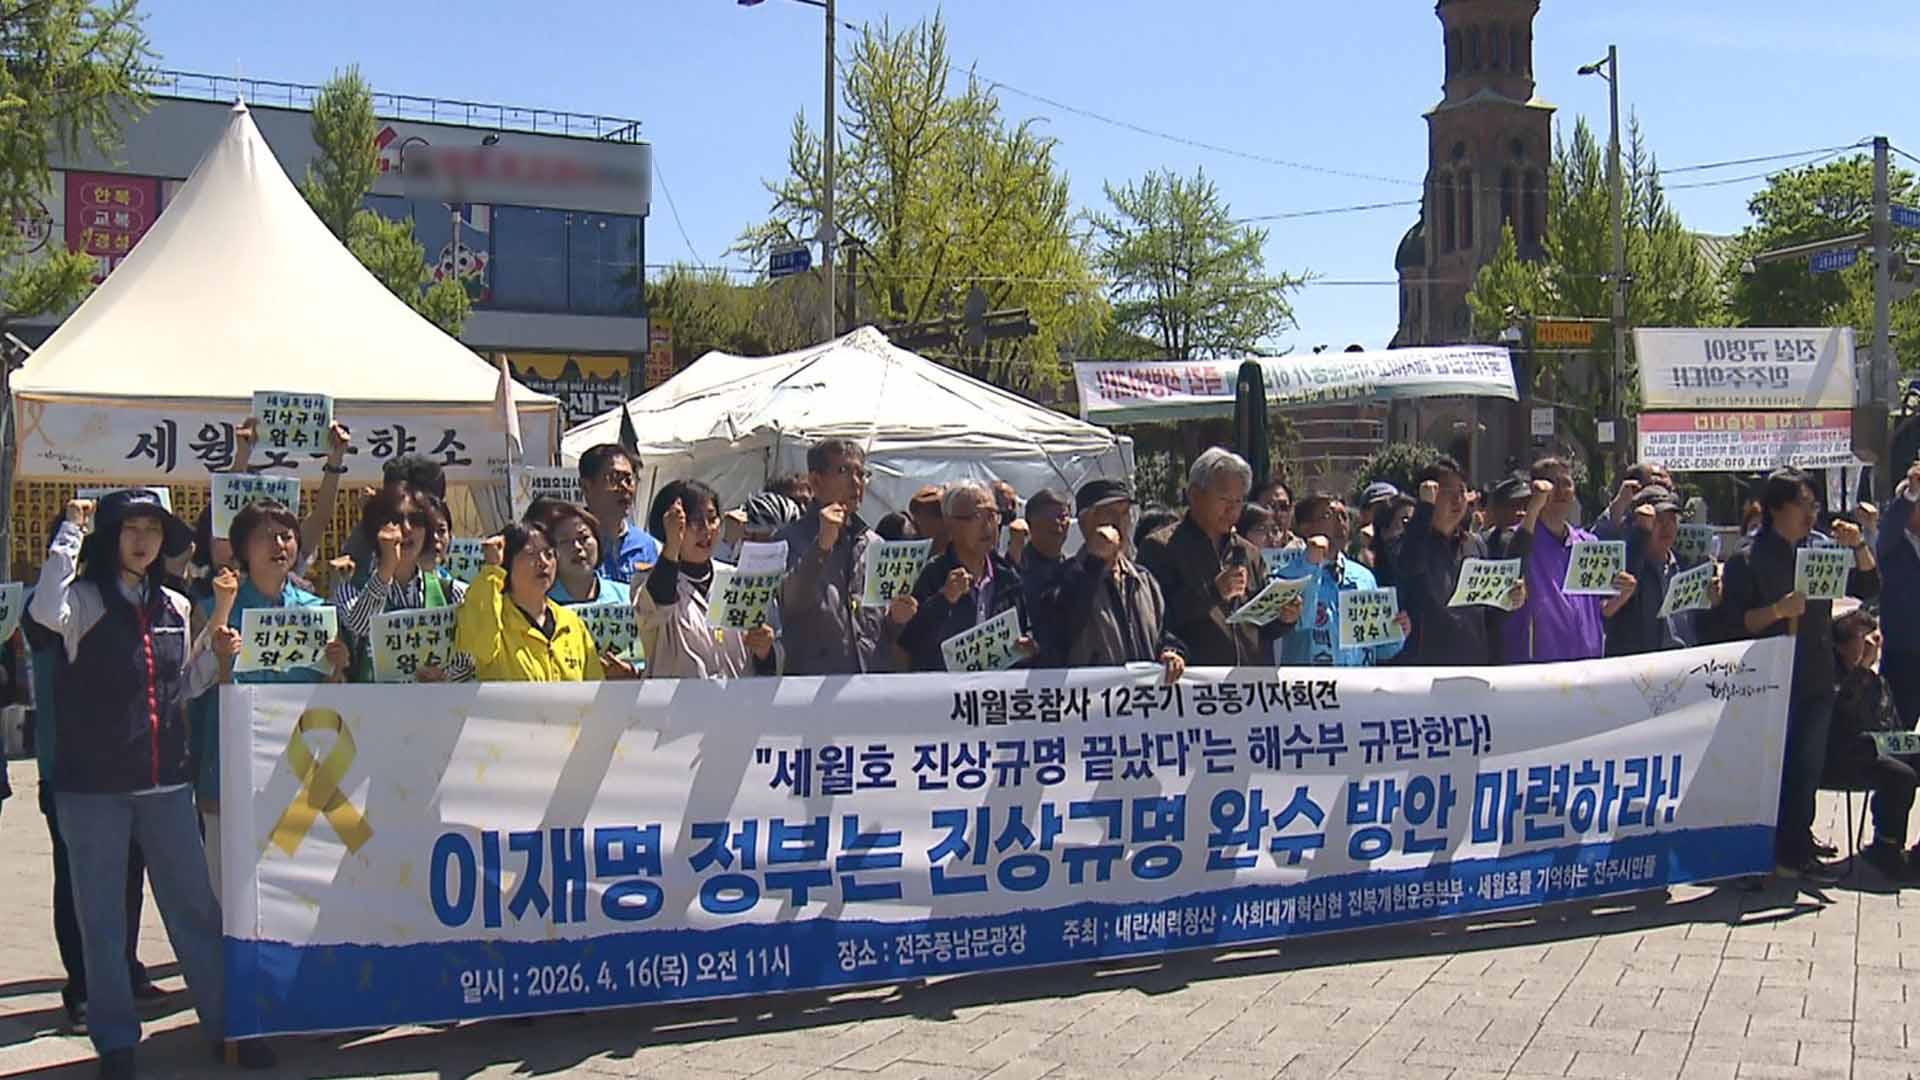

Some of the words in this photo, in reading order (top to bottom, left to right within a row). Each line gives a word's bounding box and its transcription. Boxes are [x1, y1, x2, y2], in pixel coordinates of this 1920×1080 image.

[263, 410, 326, 426] 진상규명
[254, 629, 328, 648] 진상규명
[951, 687, 1090, 726] 세월호참사
[1099, 682, 1184, 718] 12주기
[1193, 679, 1341, 716] 공동기자회견
[757, 744, 898, 798] "세월호
[911, 735, 1068, 792] 진상규명
[1081, 728, 1237, 782] 끝났다"는
[1247, 721, 1349, 771] 해수부
[1358, 714, 1492, 764] 규탄한다!
[429, 823, 664, 930] 이재명
[689, 812, 903, 916] 정부는
[926, 793, 1188, 899] 진상규명
[1206, 786, 1327, 872] 완수
[1346, 773, 1457, 861] 방안
[1471, 754, 1682, 846] 마련하라!
[1062, 917, 1099, 948] 주최
[1115, 904, 1216, 944] 내란세력청산
[1232, 893, 1343, 932] 사회대개혁실현
[1537, 863, 1590, 894] 기억하는
[460, 967, 504, 1004] 일시
[527, 962, 590, 997] 2026.
[597, 962, 617, 991] 4.
[625, 953, 689, 990] 16(목)
[696, 949, 737, 981] 오전
[745, 944, 791, 978] 11시
[838, 938, 878, 971] 장소
[895, 924, 1028, 966] 전주풍남문광장
